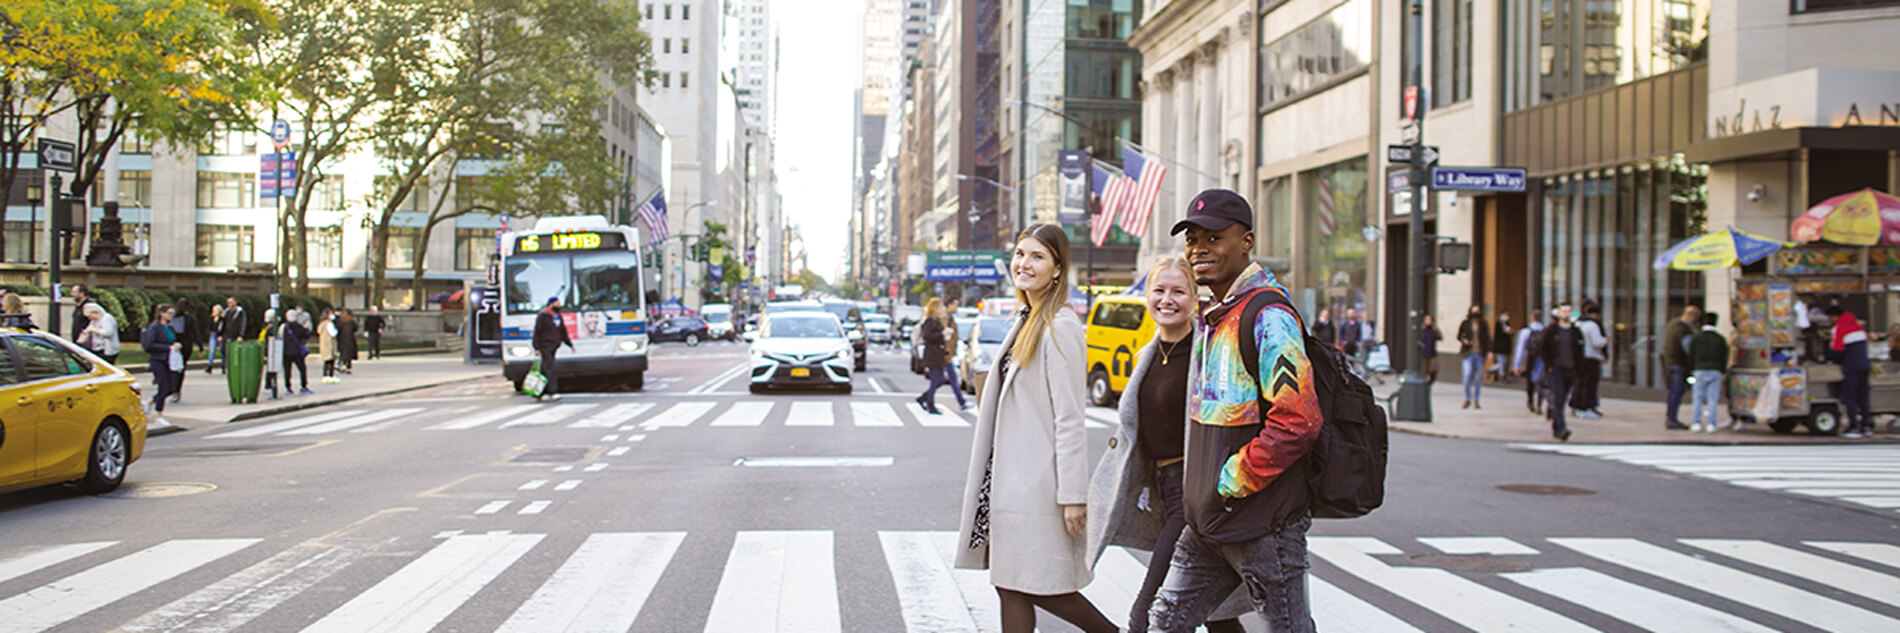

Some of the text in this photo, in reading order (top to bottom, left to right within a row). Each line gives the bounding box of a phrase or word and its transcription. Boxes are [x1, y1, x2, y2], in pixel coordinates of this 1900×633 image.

[1448, 172, 1522, 190] Library Way
[552, 233, 601, 250] LIMITED
